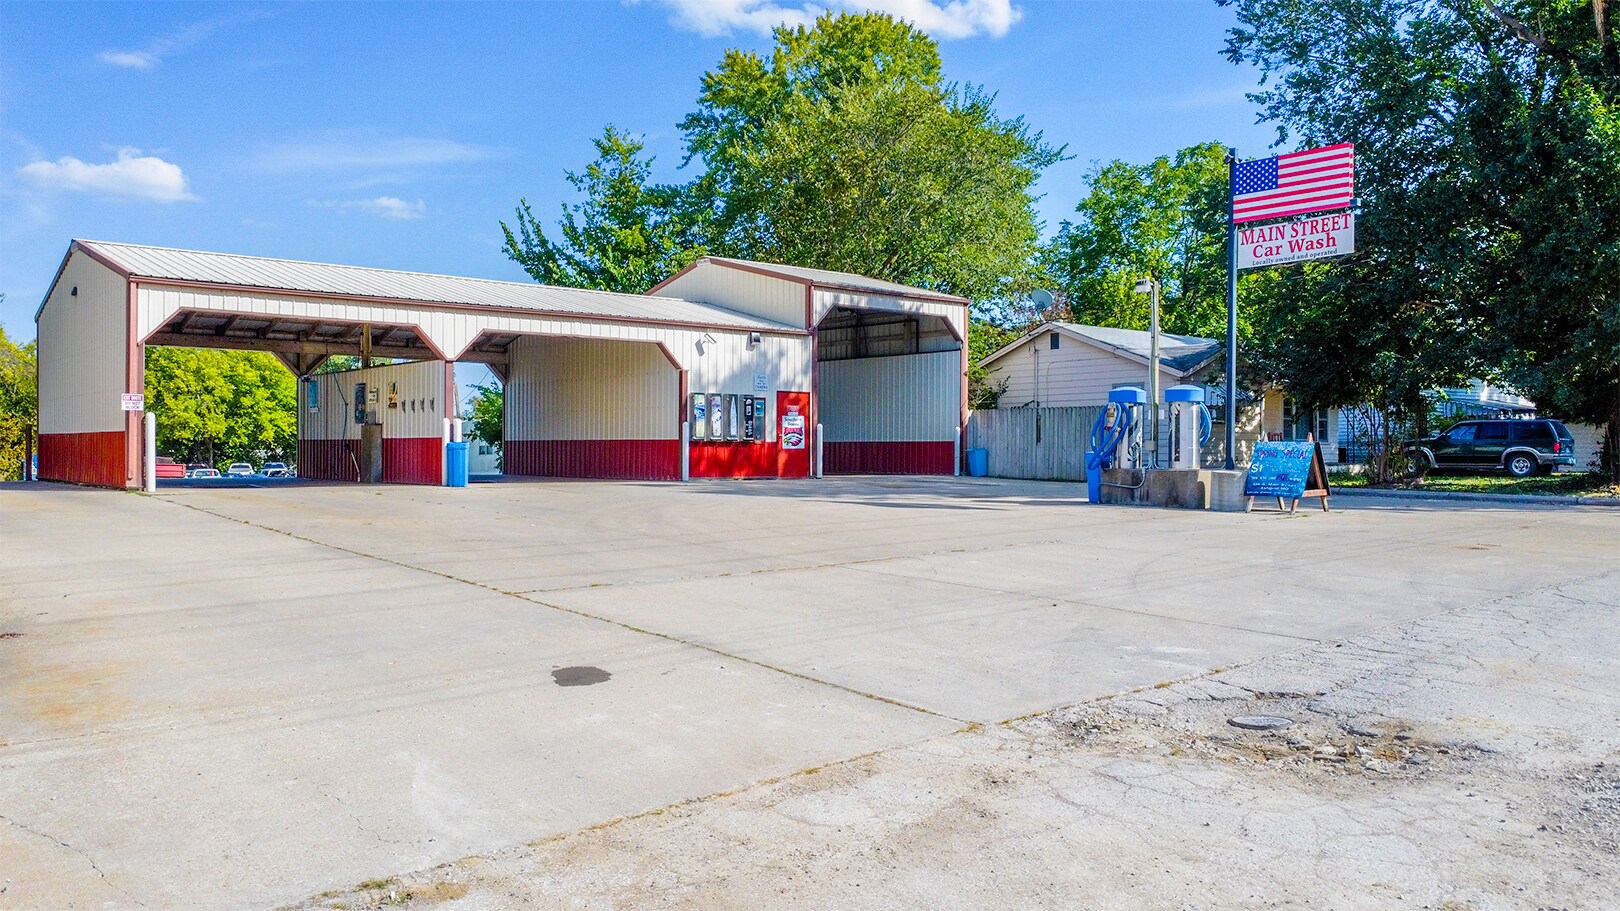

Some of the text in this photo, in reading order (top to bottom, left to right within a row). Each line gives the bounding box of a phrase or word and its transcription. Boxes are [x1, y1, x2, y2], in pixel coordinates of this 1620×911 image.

[1240, 213, 1352, 246] MAIN STREET
[1253, 232, 1337, 259] Car Wash
[1275, 254, 1296, 263] owned
[1296, 252, 1309, 260] and
[1310, 248, 1338, 260] operated
[1280, 449, 1307, 459] SPECIAL
